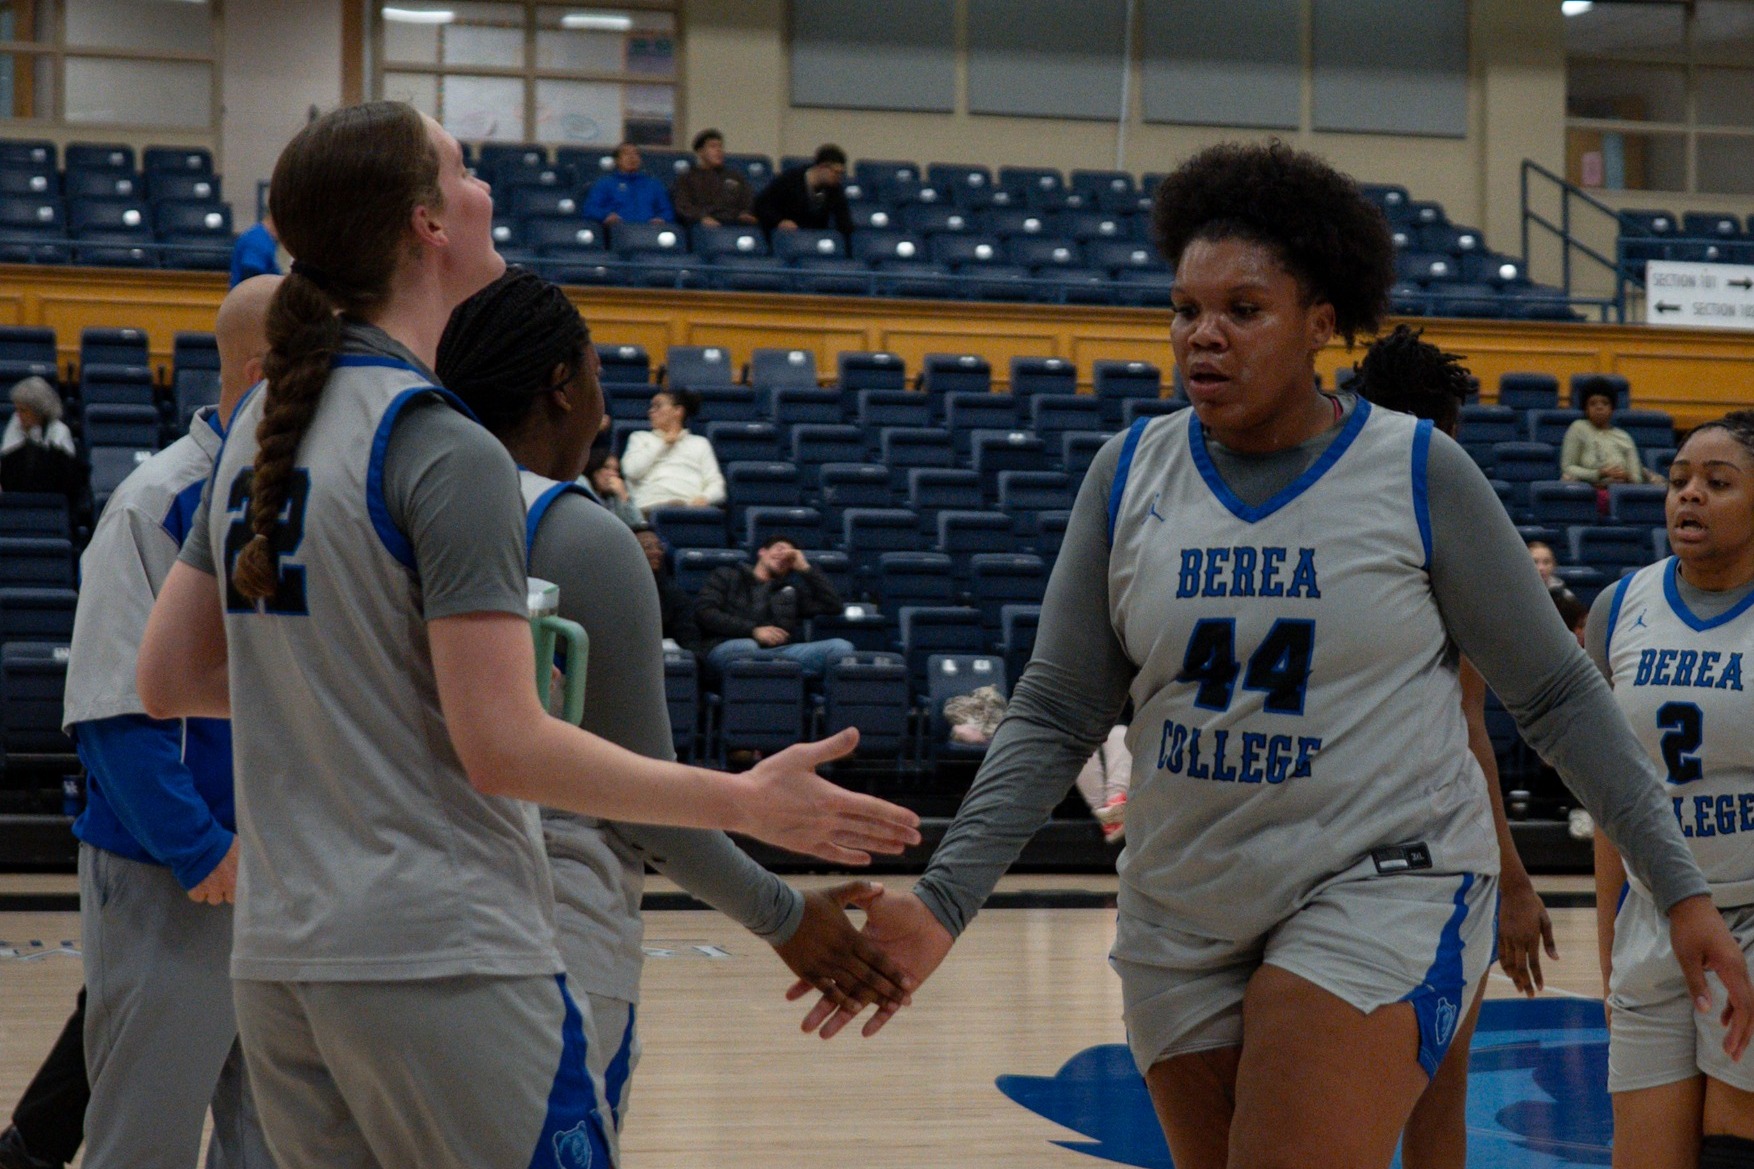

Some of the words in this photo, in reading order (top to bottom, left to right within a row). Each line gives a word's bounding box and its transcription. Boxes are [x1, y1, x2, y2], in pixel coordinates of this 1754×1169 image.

[1176, 546, 1321, 599] BEREA
[1176, 617, 1316, 716] 44
[1633, 648, 1743, 691] BEREA
[1157, 719, 1322, 784] COLLEGE
[1656, 700, 1703, 785] 2
[1672, 793, 1754, 838] LEGE
